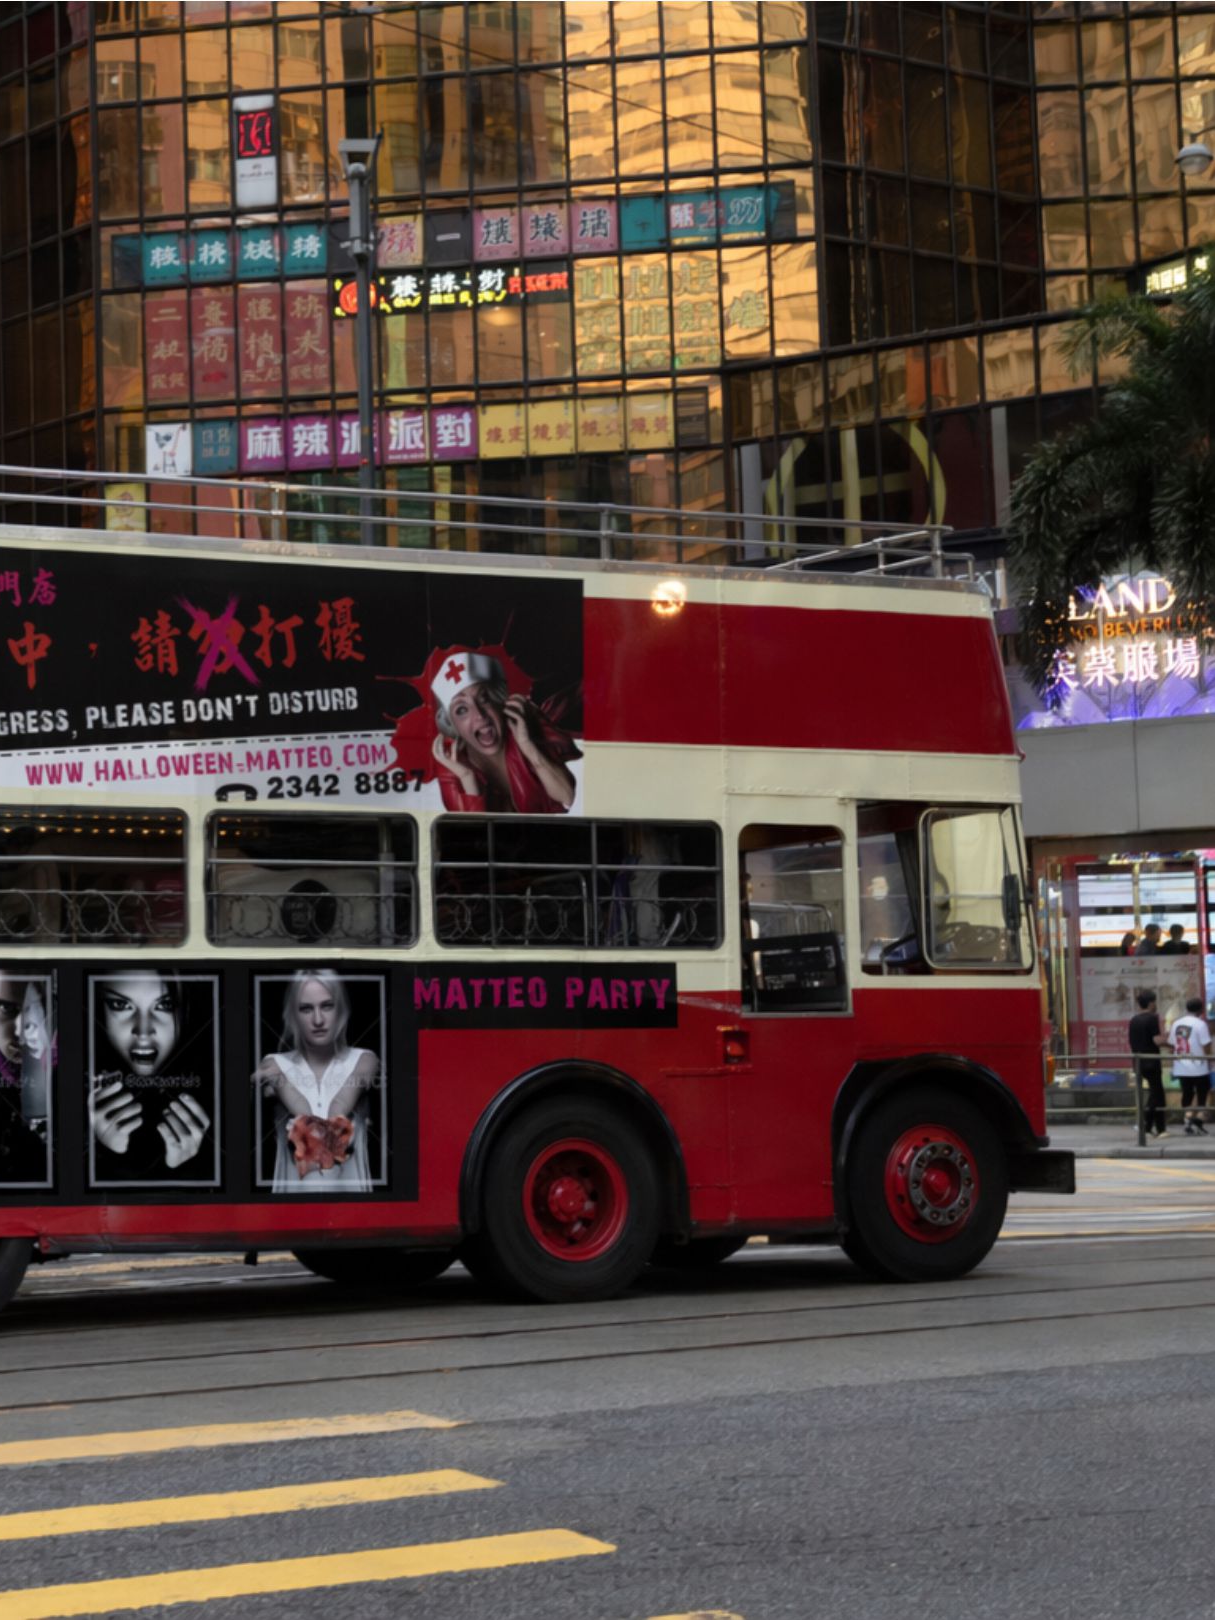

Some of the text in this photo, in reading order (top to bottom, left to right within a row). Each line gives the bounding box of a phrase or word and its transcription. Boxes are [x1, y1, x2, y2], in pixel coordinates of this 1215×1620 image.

[86, 701, 176, 729] PLEASE
[182, 694, 259, 723] DON'T
[269, 687, 358, 715] DISTURB
[25, 743, 388, 786] WWW.HALLOWEEN-MATTEO.COM
[267, 770, 426, 800] 2342 8887
[413, 976, 671, 1010] MATTEO PARTY
